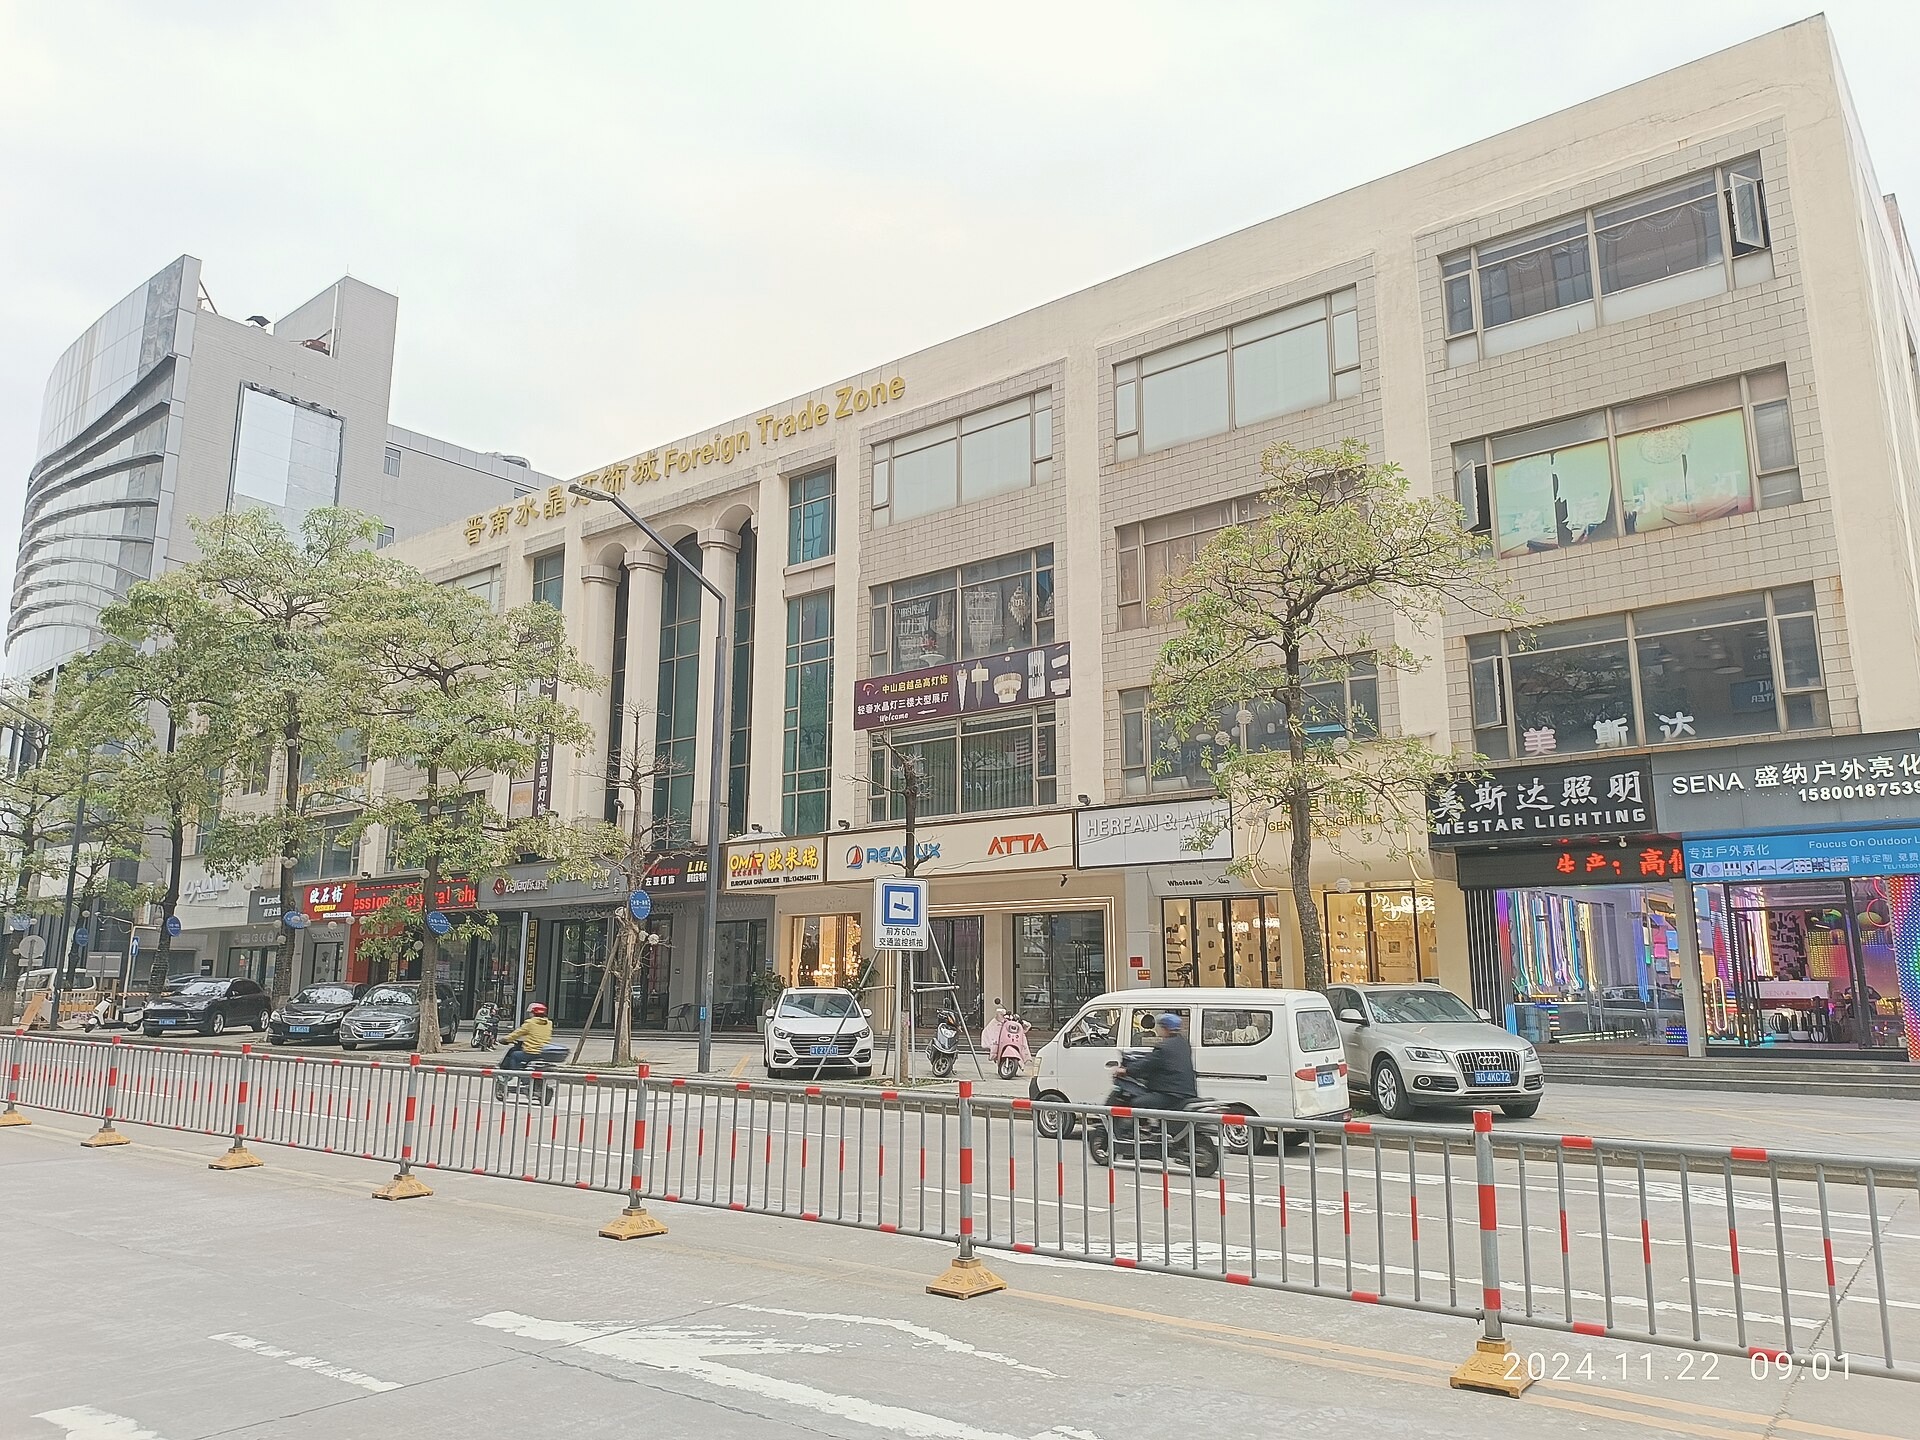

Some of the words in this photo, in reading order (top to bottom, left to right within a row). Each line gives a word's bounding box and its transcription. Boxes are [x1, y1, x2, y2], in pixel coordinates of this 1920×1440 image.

[664, 432, 750, 478] Foreign
[757, 402, 829, 445] Trade
[834, 375, 907, 420] Zone
[1672, 772, 1745, 795] SENA
[1087, 813, 1159, 838] HERFAN
[1161, 812, 1177, 831] &
[1436, 816, 1526, 835] MESTAR
[1535, 808, 1647, 829] LIGHTING
[988, 833, 1049, 855] ATTA
[1808, 840, 1847, 849] Foucus
[1849, 838, 1865, 847] On
[1867, 837, 1911, 846] Outdoor
[1167, 879, 1203, 887] Wholesale
